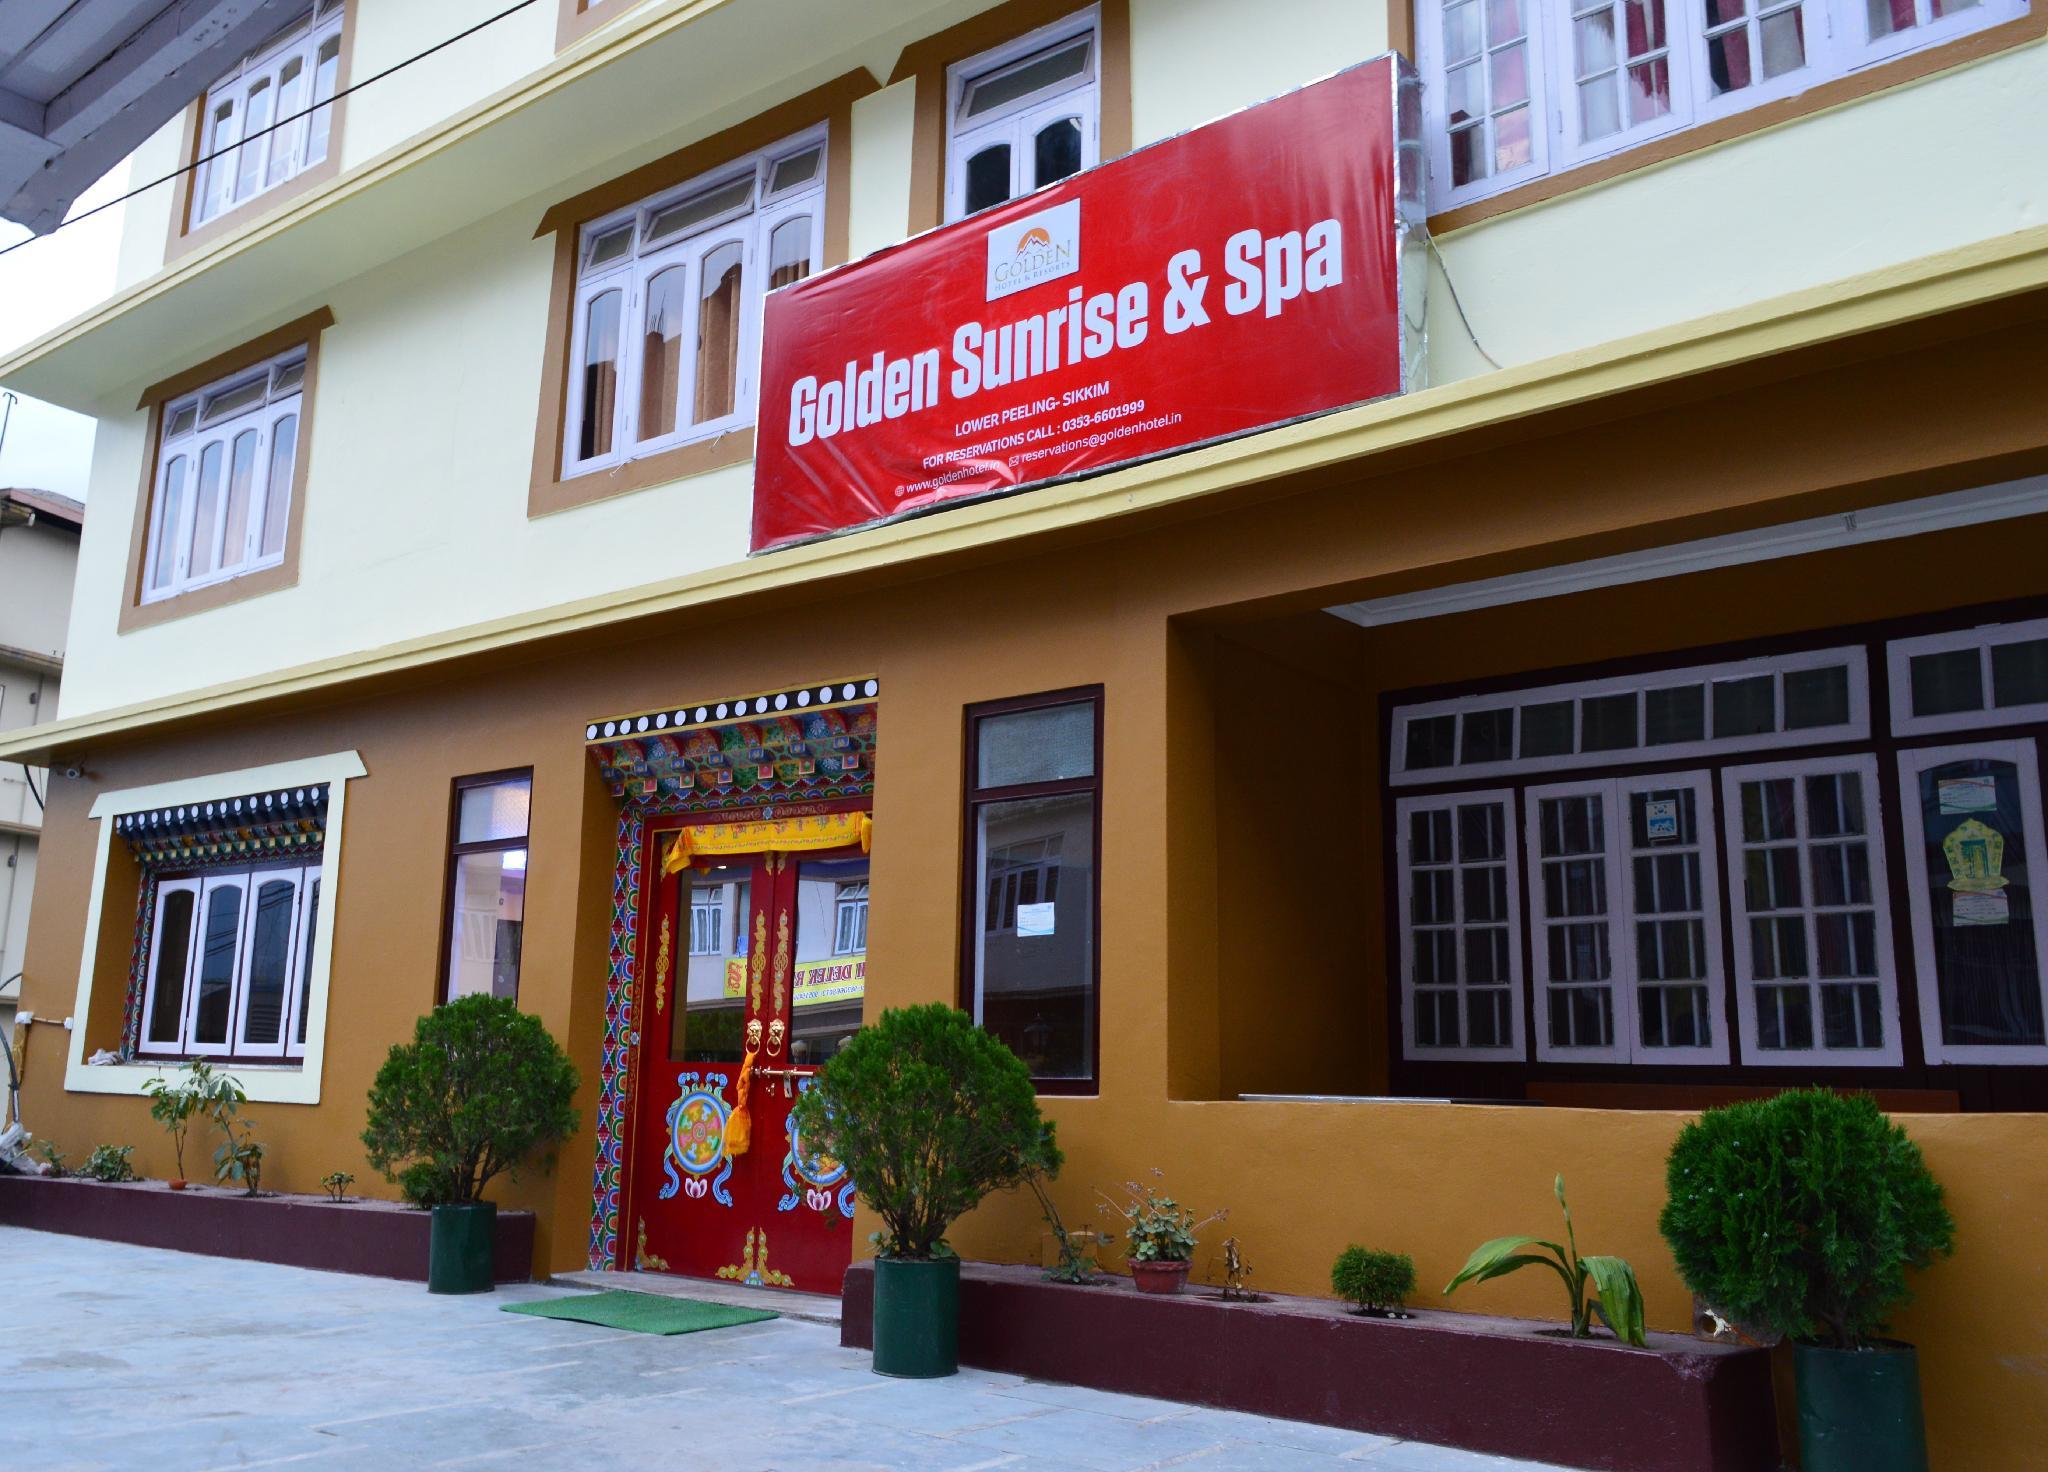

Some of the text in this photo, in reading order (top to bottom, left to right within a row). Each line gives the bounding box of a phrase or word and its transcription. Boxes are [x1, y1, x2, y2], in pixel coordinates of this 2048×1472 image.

[995, 240, 1070, 281] GOLDEN
[995, 277, 1021, 290] HOTEL
[789, 219, 1343, 446] Golden Sunrise & Spa
[923, 454, 944, 469] FOR
[945, 433, 1025, 462] RESERVATIONS
[1026, 425, 1055, 442] CALL
[1062, 400, 1145, 433] 0353-6601999
[955, 381, 1110, 437] LOWER PEELING- SIKKIM
[906, 412, 1182, 493] www.goldenhotel.in reservations@goldenhotel.in
